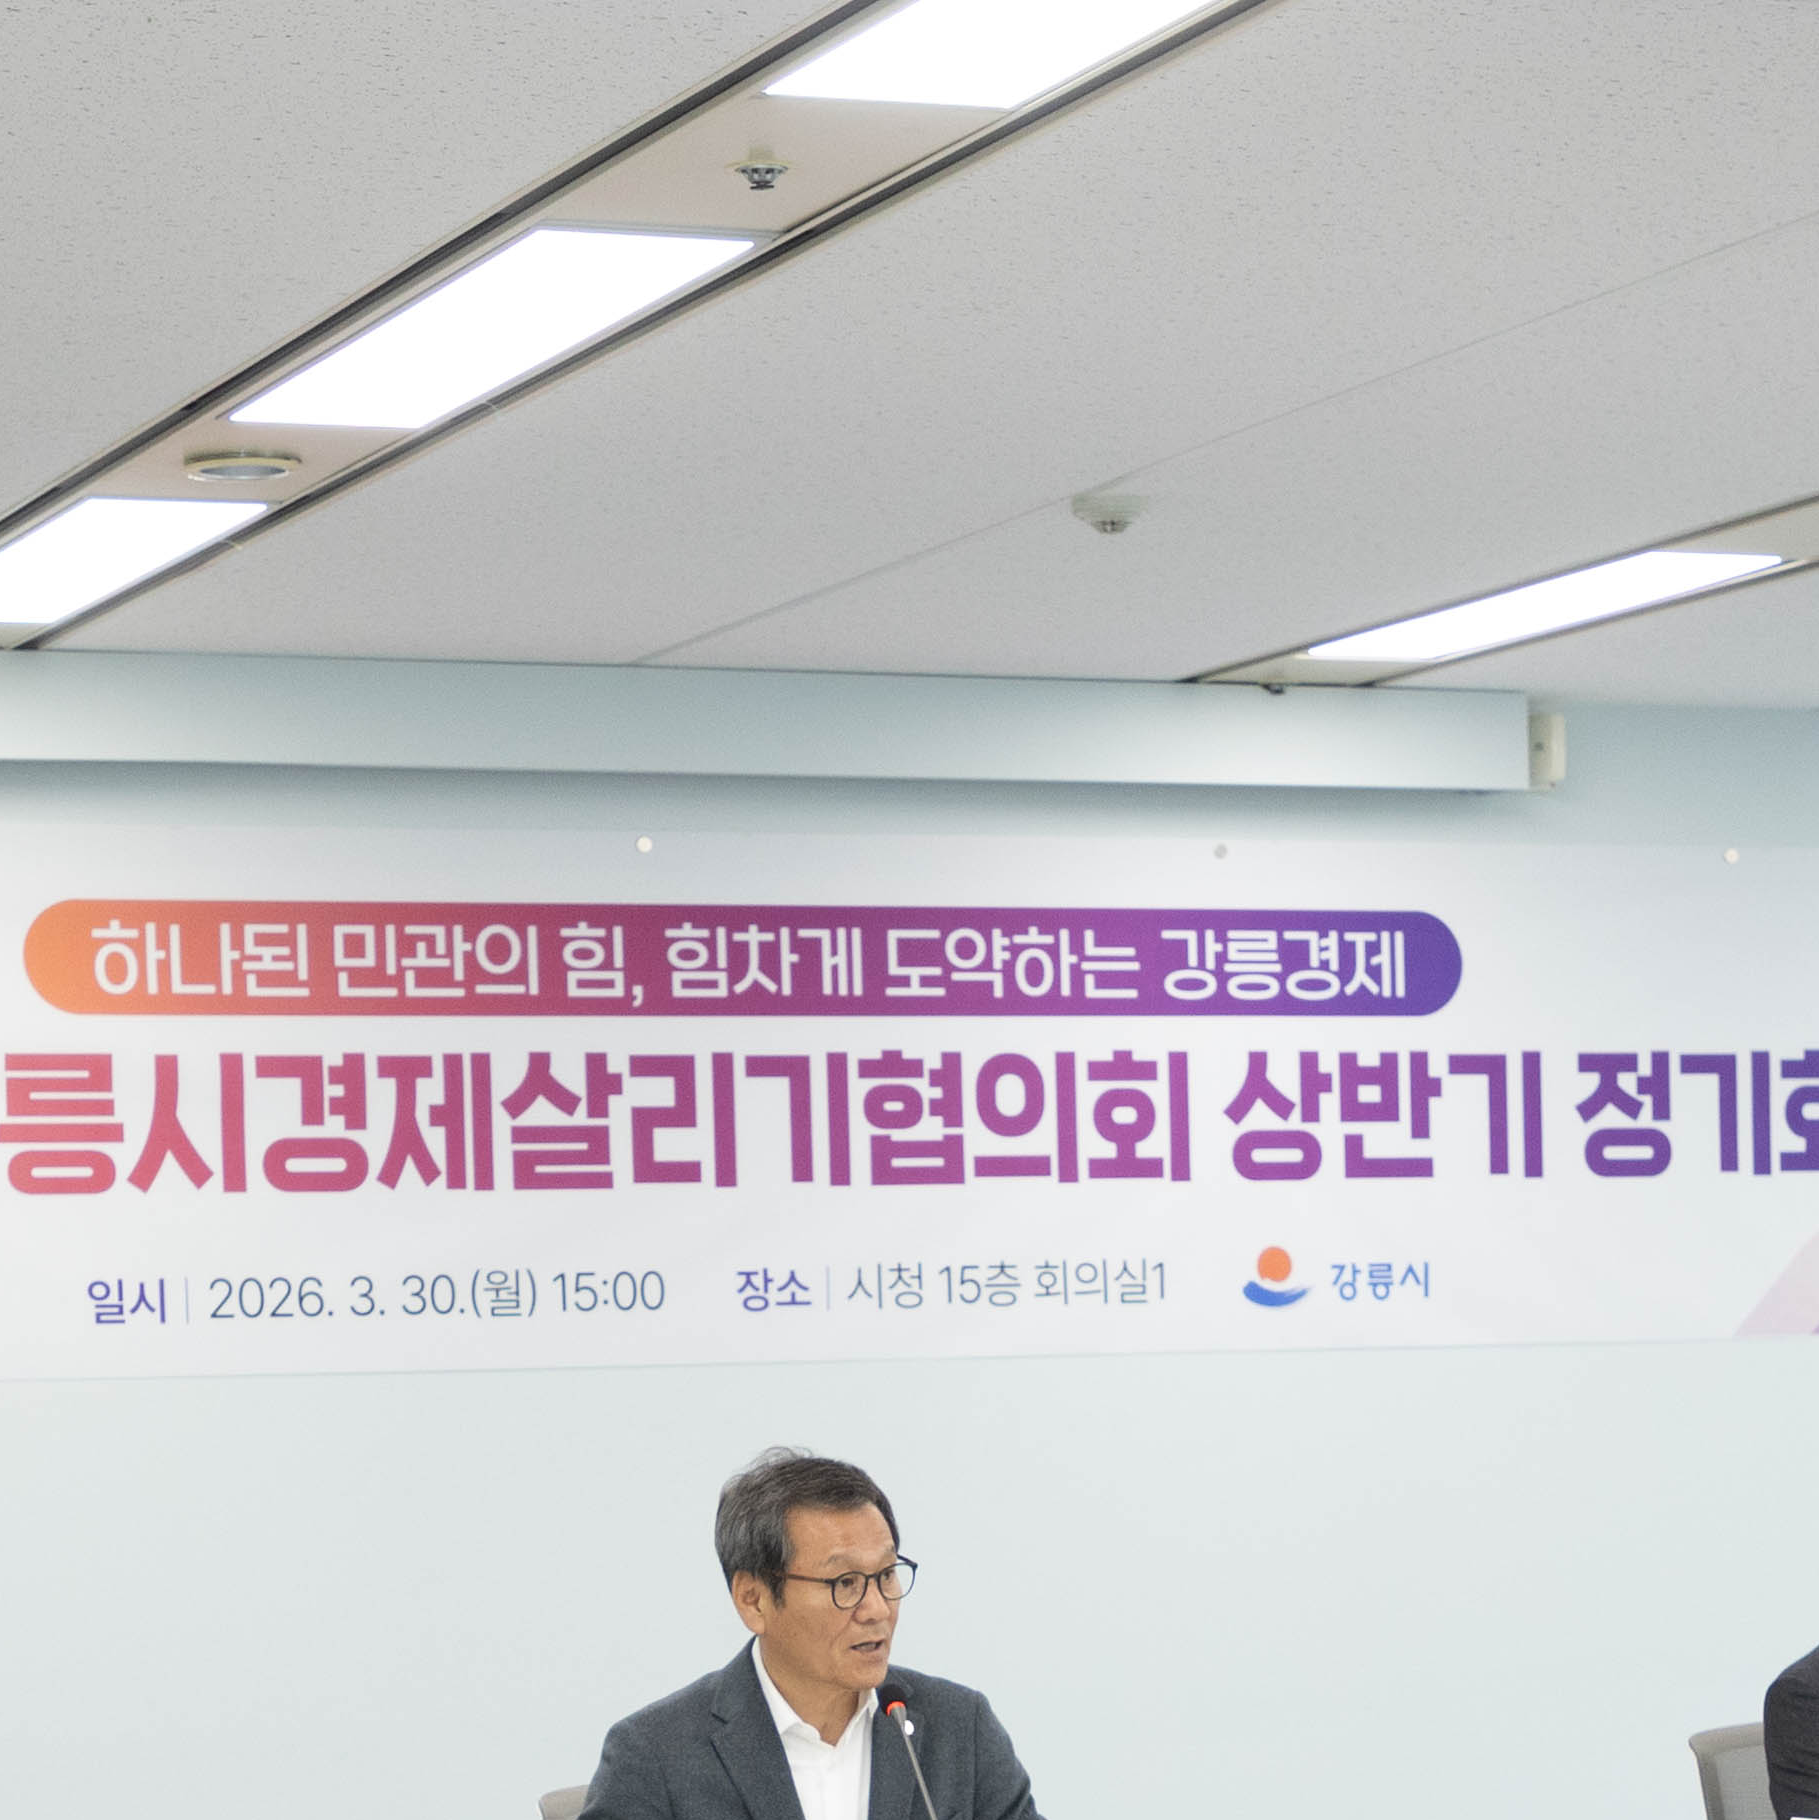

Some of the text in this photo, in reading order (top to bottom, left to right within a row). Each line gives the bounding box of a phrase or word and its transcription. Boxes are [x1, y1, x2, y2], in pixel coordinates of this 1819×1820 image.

[92, 919, 1405, 1006] 하나된 민관의 힘, 힘차게 도약하는 강릉경제
[1224, 1050, 1543, 1182] 상반기
[87, 1277, 167, 1325] 일시
[209, 1276, 335, 1319] 2026.
[350, 1275, 386, 1317] 3.
[552, 1270, 666, 1313] 15:00
[736, 1258, 1166, 1313] 장소 시청 15층 회의실1
[1330, 1261, 1430, 1302] 강릉시
